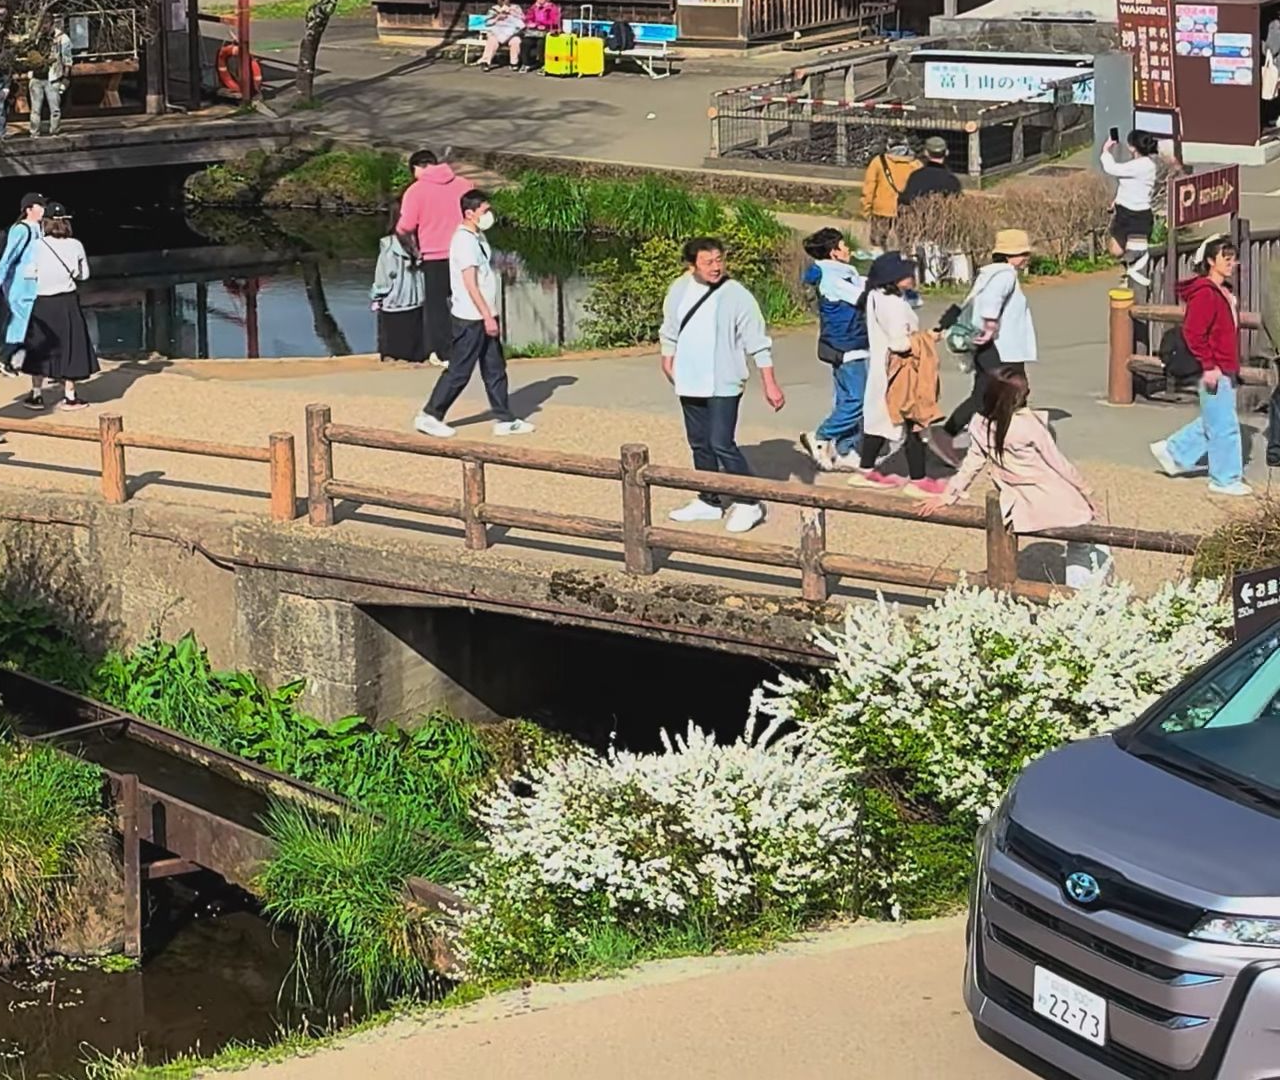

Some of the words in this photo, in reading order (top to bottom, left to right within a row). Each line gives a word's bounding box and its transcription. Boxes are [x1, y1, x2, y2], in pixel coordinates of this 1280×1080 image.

[1119, 4, 1168, 16] WAKUIKE
[1179, 183, 1196, 222] P
[1049, 994, 1099, 1037] 22-73
